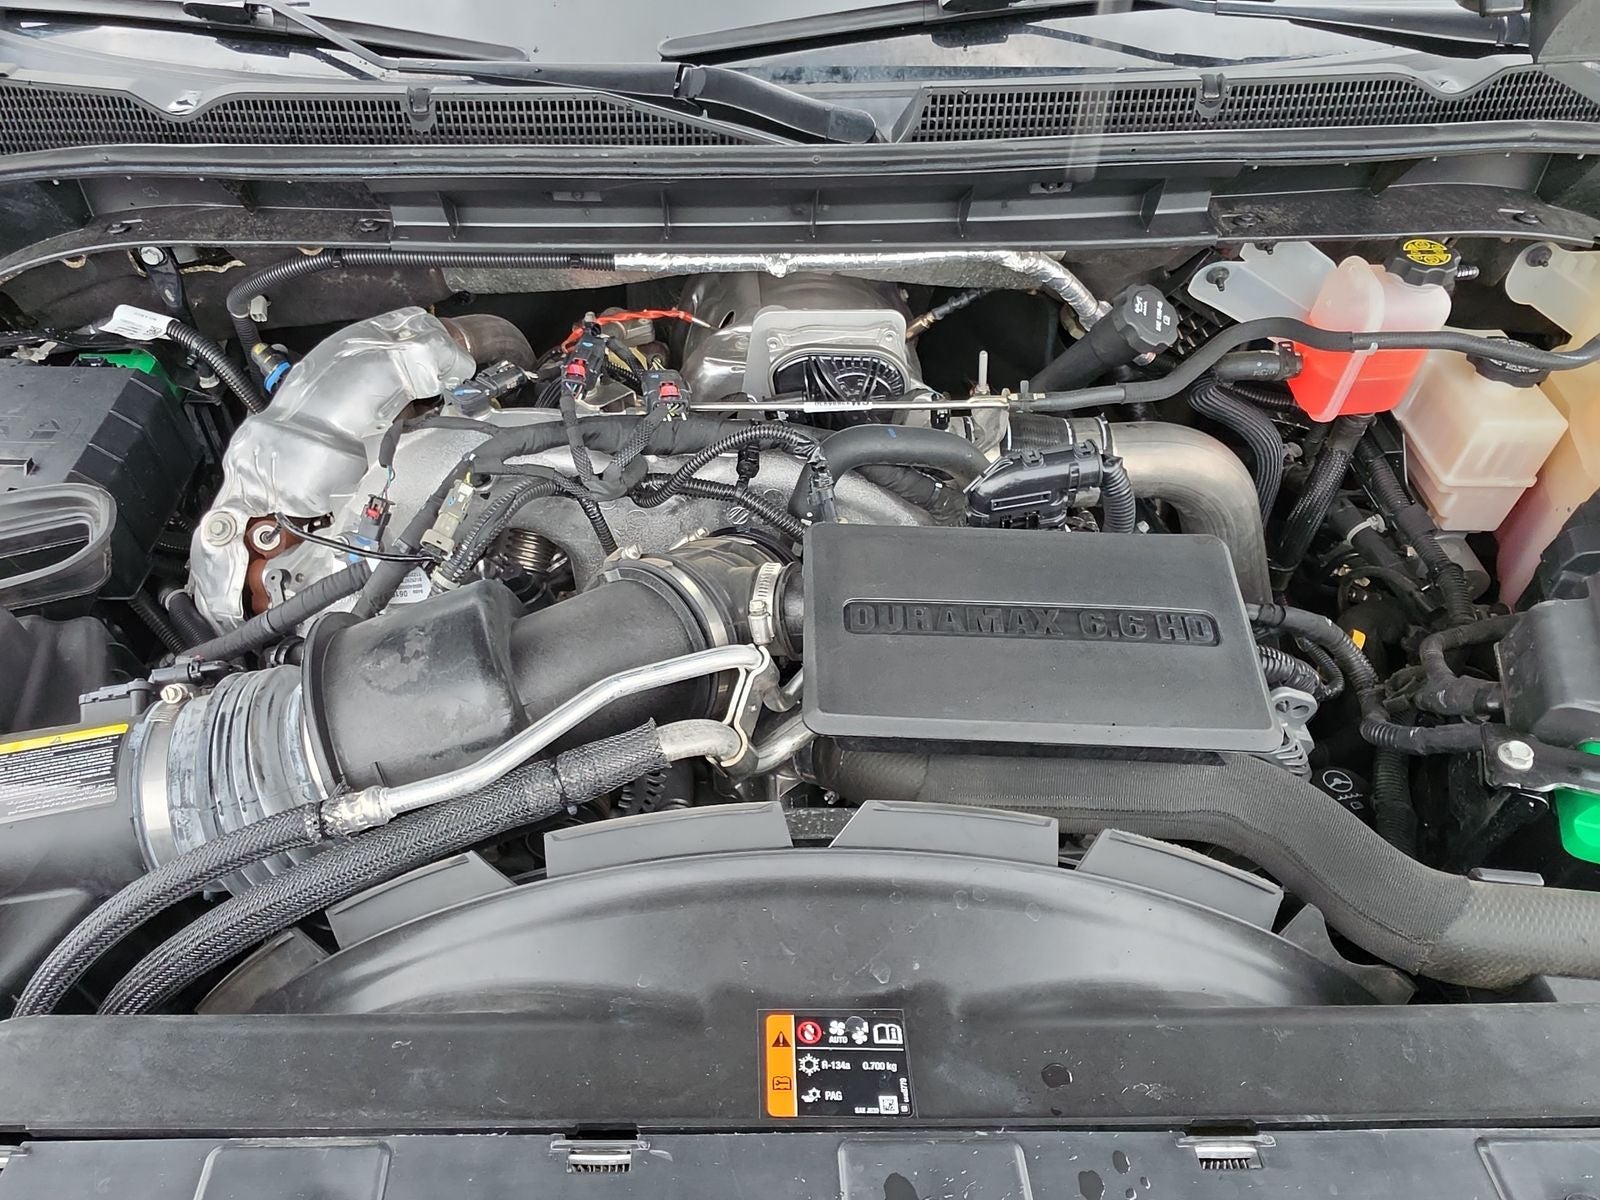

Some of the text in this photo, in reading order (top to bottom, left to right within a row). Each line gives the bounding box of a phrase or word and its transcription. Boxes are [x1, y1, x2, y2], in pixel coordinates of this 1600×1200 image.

[852, 605, 1214, 643] DURAMAX 6.6 HD
[828, 1035, 848, 1044] AUTO
[821, 1060, 897, 1072] R-134a 0.700 kg
[824, 1090, 843, 1101] PAG
